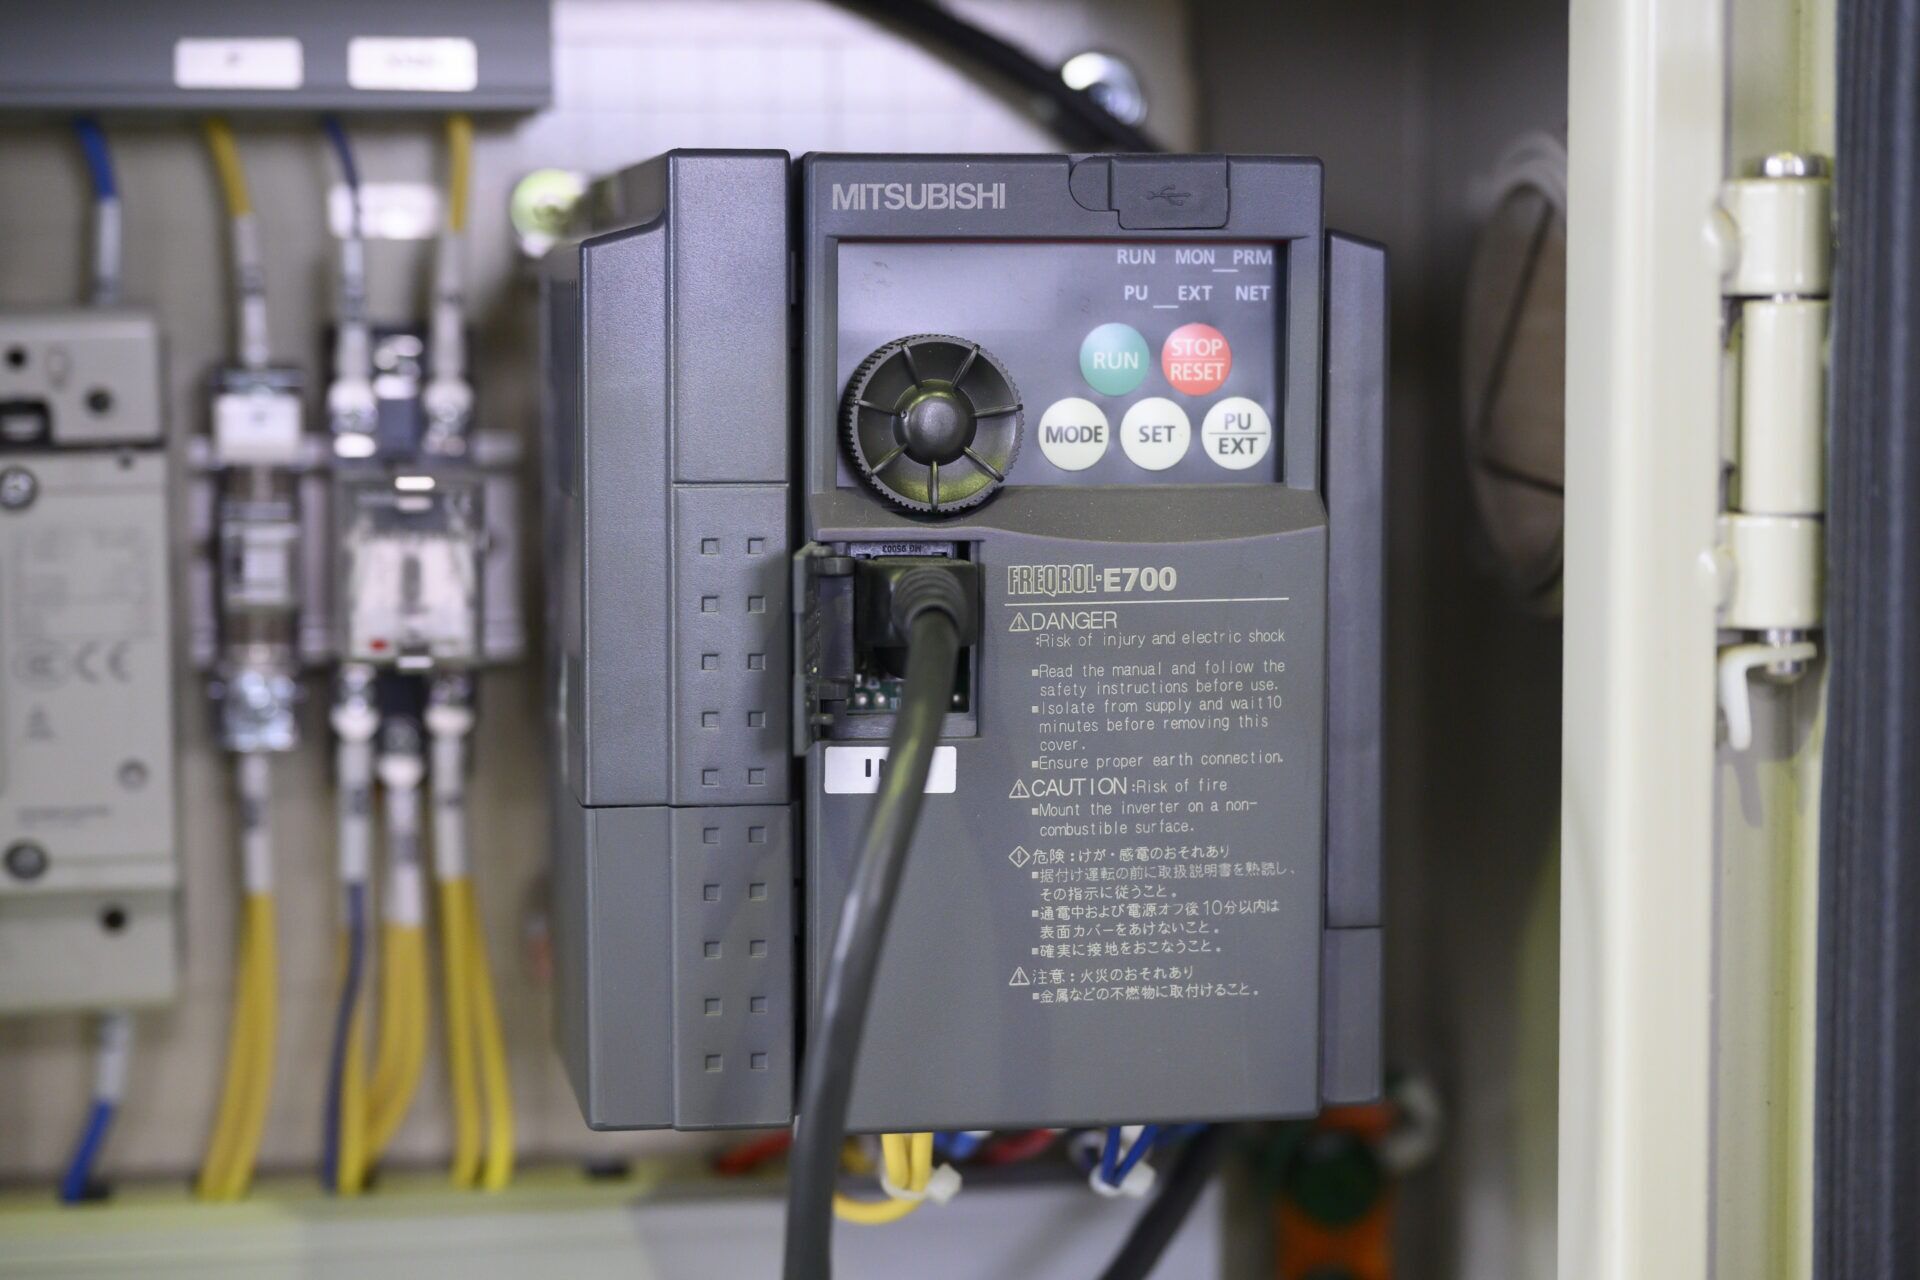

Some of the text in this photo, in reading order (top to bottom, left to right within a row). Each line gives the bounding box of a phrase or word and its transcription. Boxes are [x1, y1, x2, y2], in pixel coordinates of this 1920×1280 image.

[833, 183, 1005, 210] MITSUBISHI
[1117, 248, 1273, 264] RUN MON PRM
[1125, 285, 1270, 301] PU EXT NET
[1171, 340, 1223, 357] STOP
[1094, 352, 1138, 369] RUN
[1170, 363, 1224, 381] RESET
[1225, 413, 1251, 430] PU
[1046, 426, 1102, 443] MODE
[1139, 425, 1176, 443] SET
[1219, 438, 1257, 454] EXT
[1032, 611, 1117, 630] DANGER
[1079, 633, 1092, 646] of
[1104, 632, 1145, 648] injury
[1152, 632, 1175, 644] and
[1182, 631, 1241, 644] electric
[1249, 629, 1285, 642] shock
[1040, 659, 1285, 678] Read the manual and follow the
[1040, 678, 1278, 698] safety instructions before use.
[1105, 699, 1137, 713] from
[1146, 698, 1191, 714] supply
[1199, 697, 1222, 711] and
[1040, 714, 1268, 733] minutes before removing this
[1040, 739, 1086, 751] cover.
[1040, 756, 1088, 769] Ensure
[1097, 757, 1143, 770] proper
[1153, 752, 1192, 766] earth
[1175, 778, 1188, 792] of
[1199, 778, 1227, 791] fire
[1040, 803, 1079, 816] Mount
[1091, 802, 1111, 815] the
[1122, 801, 1179, 814] inverter
[1188, 802, 1203, 812] on
[1210, 801, 1219, 812] a
[1040, 819, 1194, 836] combustible surface.
